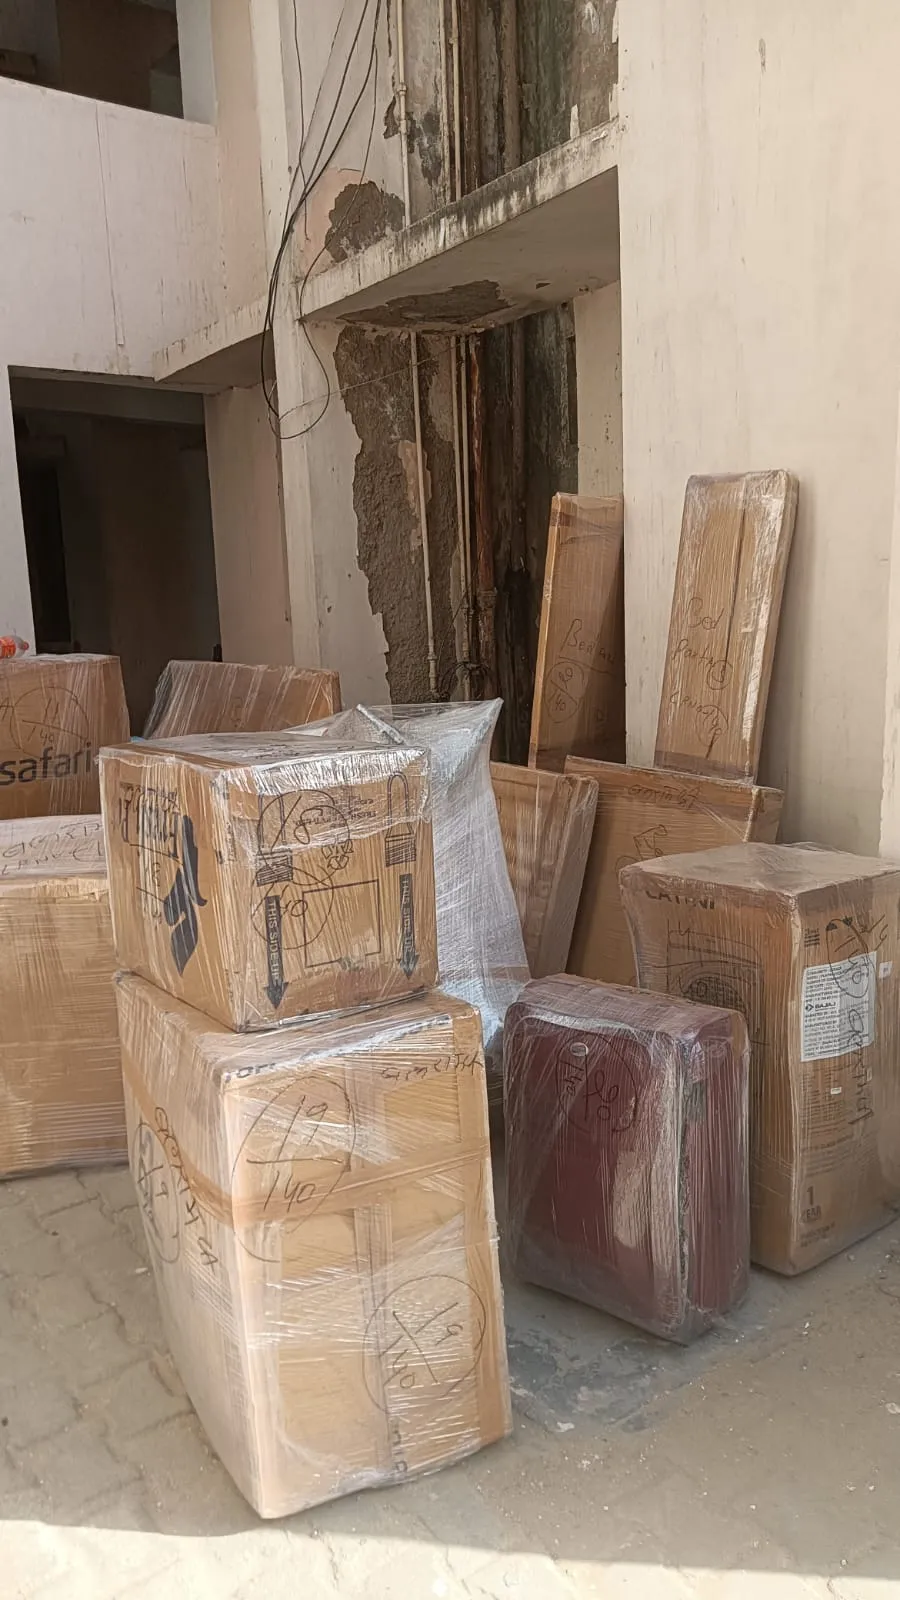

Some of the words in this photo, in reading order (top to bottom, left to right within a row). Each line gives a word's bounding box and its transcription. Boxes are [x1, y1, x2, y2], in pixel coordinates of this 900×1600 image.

[0, 742, 92, 786] safari
[267, 900, 278, 929] THIS
[269, 932, 279, 960] SIDE
[270, 962, 280, 980] UP
[276, 1095, 328, 1161] 19
[263, 1171, 317, 1213] 140
[806, 1186, 814, 1206] 1
